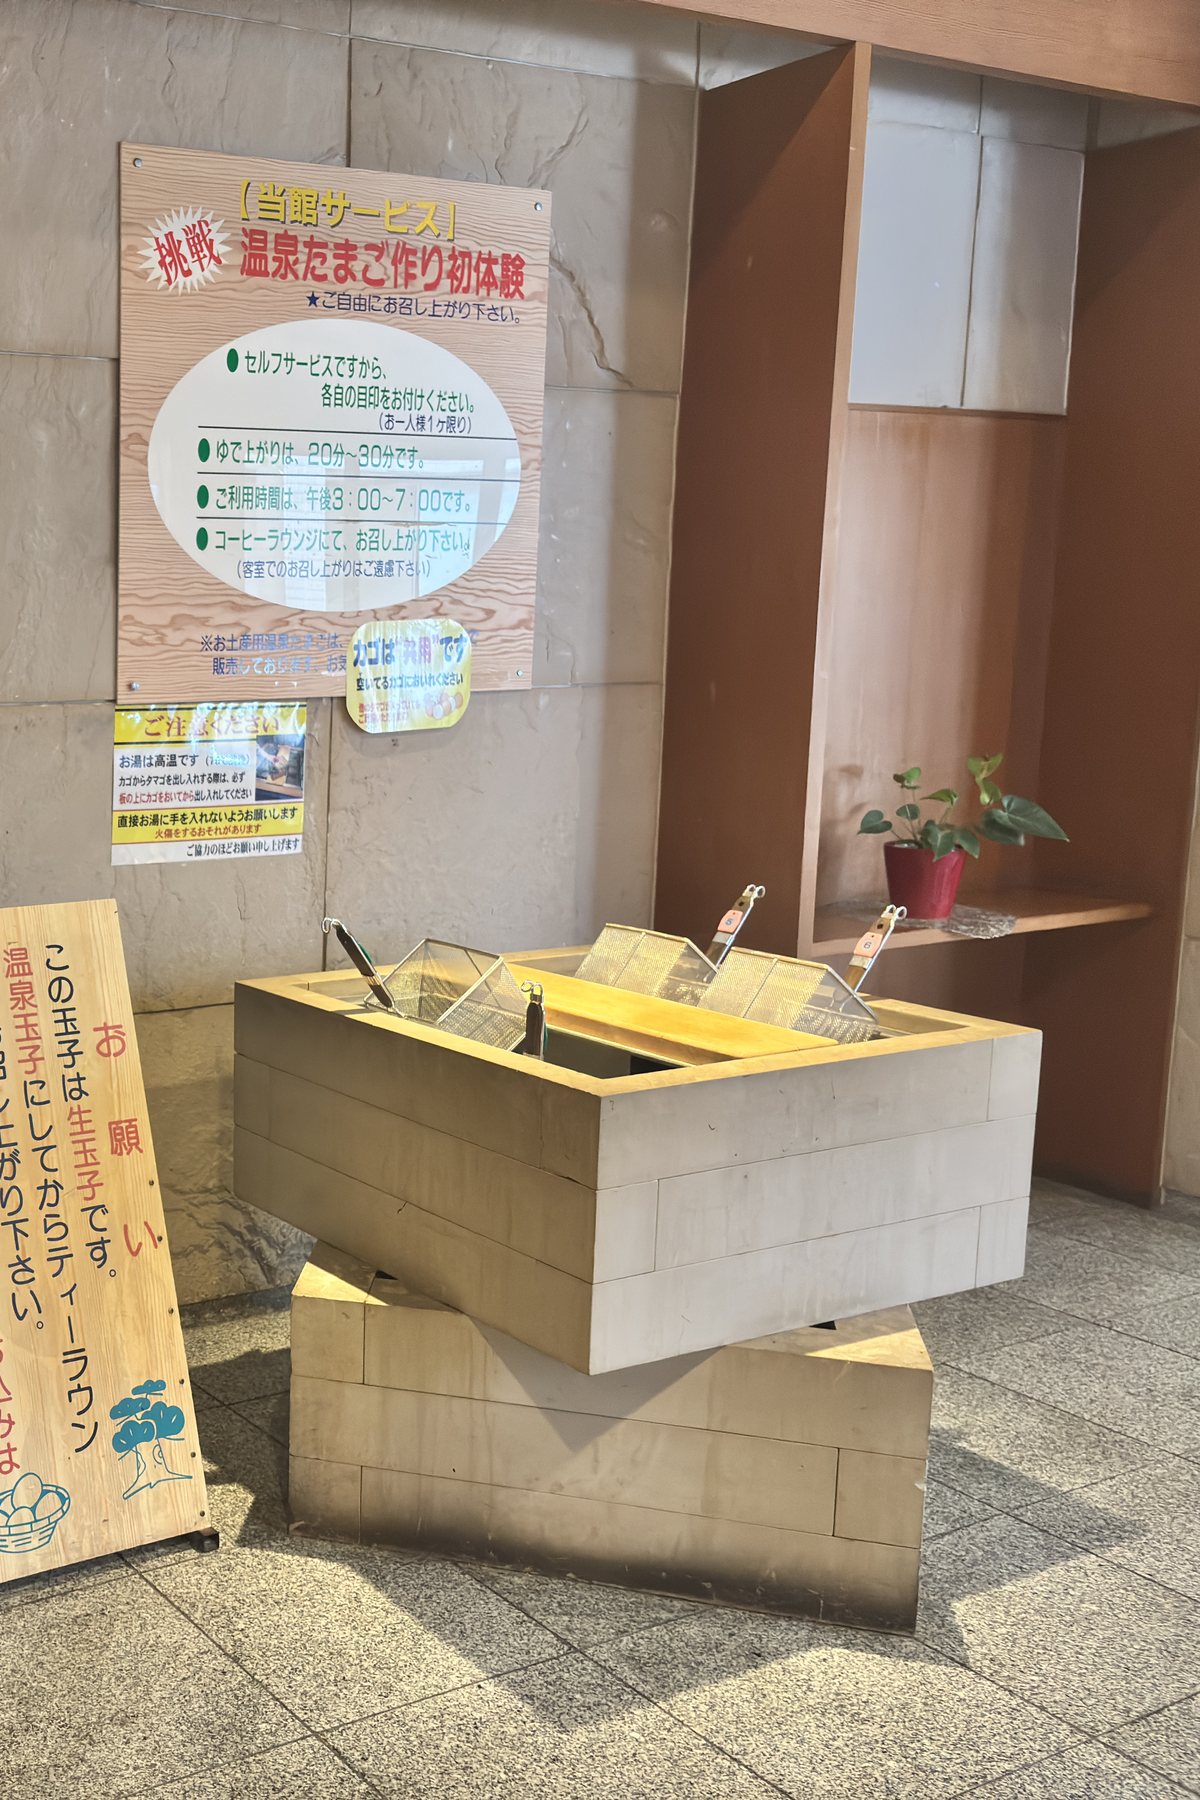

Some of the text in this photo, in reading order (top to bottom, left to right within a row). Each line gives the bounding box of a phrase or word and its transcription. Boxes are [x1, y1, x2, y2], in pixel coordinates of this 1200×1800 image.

[153, 218, 223, 286] 挑戦
[240, 227, 526, 300] 温泉たまご作り初体験
[244, 349, 387, 381] セルフサービスですから、
[321, 384, 475, 414] 各自の目印をお付けください。
[119, 753, 200, 769] お湯は高温です
[118, 806, 298, 828] 直接お湯に手を入れないようお願いします
[155, 823, 262, 840] 火傷をするおそれがあります
[187, 838, 300, 858] ご協力のほどお願い申し上げます
[44, 943, 117, 1278] この玉子は生玉子です。
[93, 1021, 159, 1258] お願い
[3, 946, 98, 1453] 温泉玉子にしてからティーラウン
